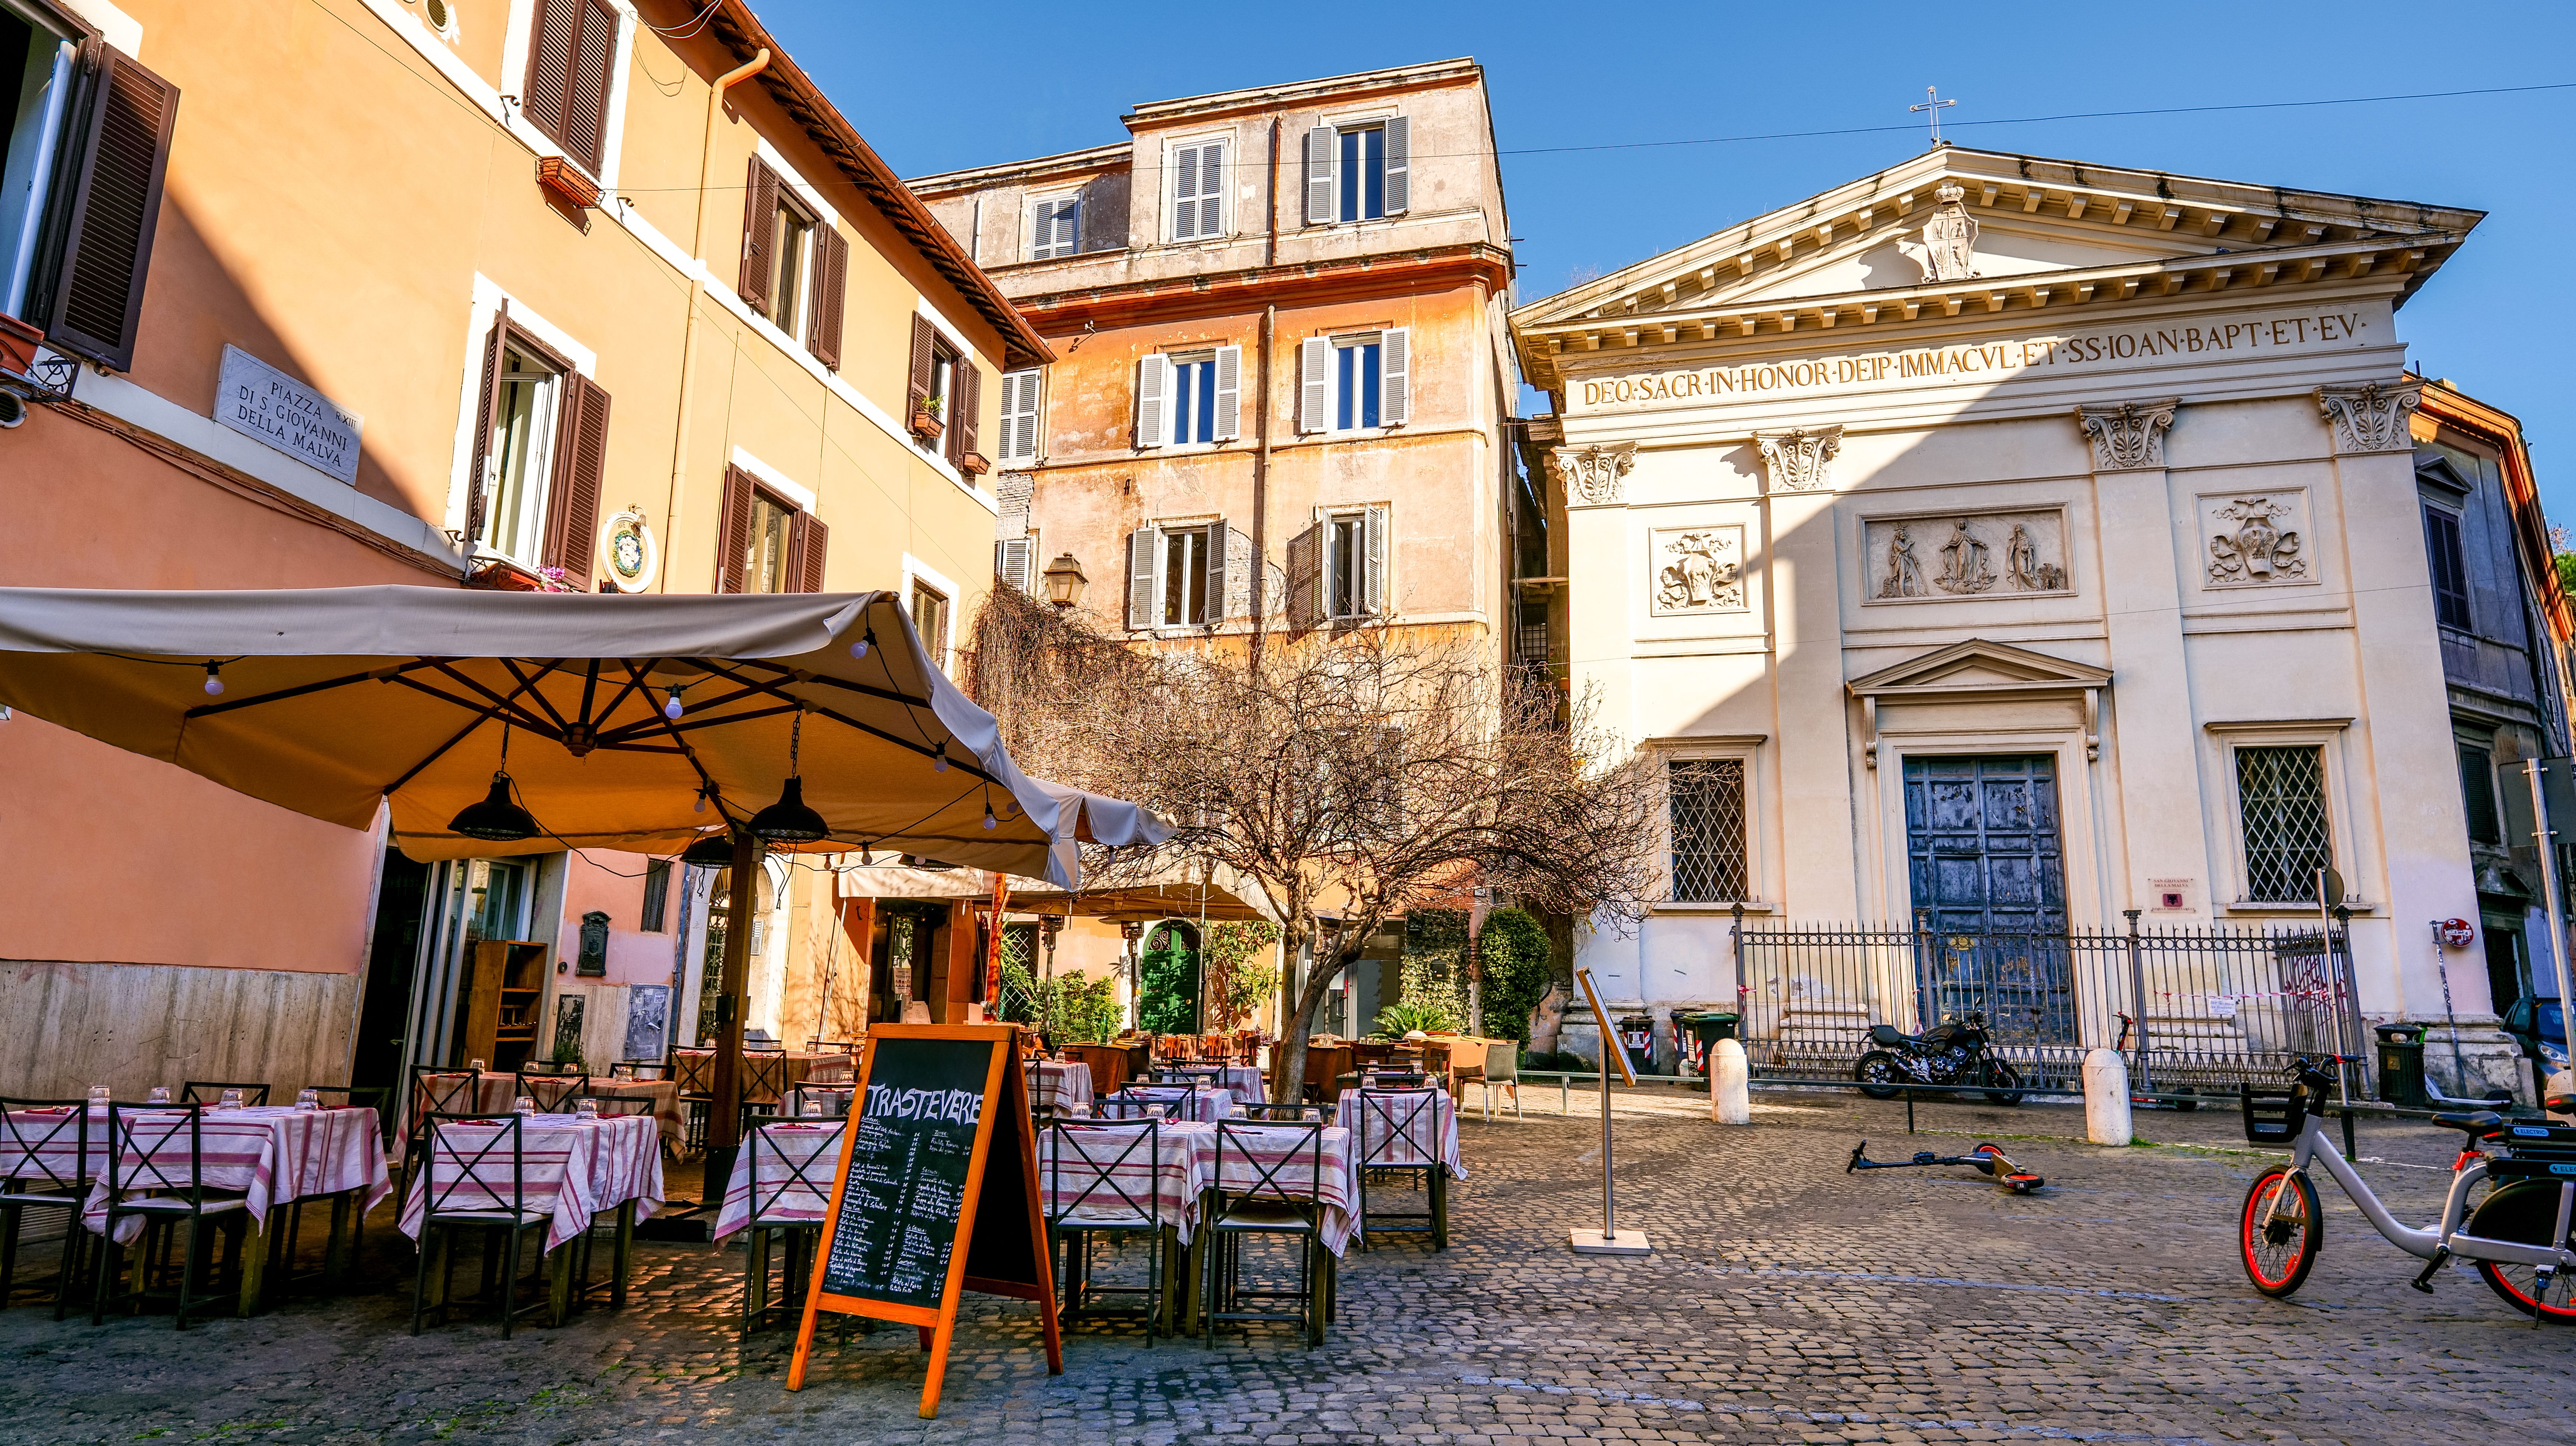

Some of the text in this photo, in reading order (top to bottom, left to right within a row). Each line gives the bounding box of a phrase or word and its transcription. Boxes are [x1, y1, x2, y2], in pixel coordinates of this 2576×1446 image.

[1585, 380, 1634, 406] DEO
[1639, 374, 1701, 401] SACR
[1709, 370, 1734, 394] IN
[1740, 362, 1830, 392] HONOR
[1838, 356, 1894, 383] DEIP
[2022, 341, 2059, 366] ET
[2068, 336, 2102, 363] SS
[2108, 328, 2178, 360] IOAN
[2185, 322, 2262, 353] BAPT
[2271, 317, 2310, 344] ET
[2319, 312, 2357, 340] EV
[239, 385, 347, 451] DI S. GIOVANNI
[270, 381, 322, 420] PIAZZA
[237, 404, 342, 467] DELLA MALVA
[867, 1083, 984, 1126] TRASTEVERE
